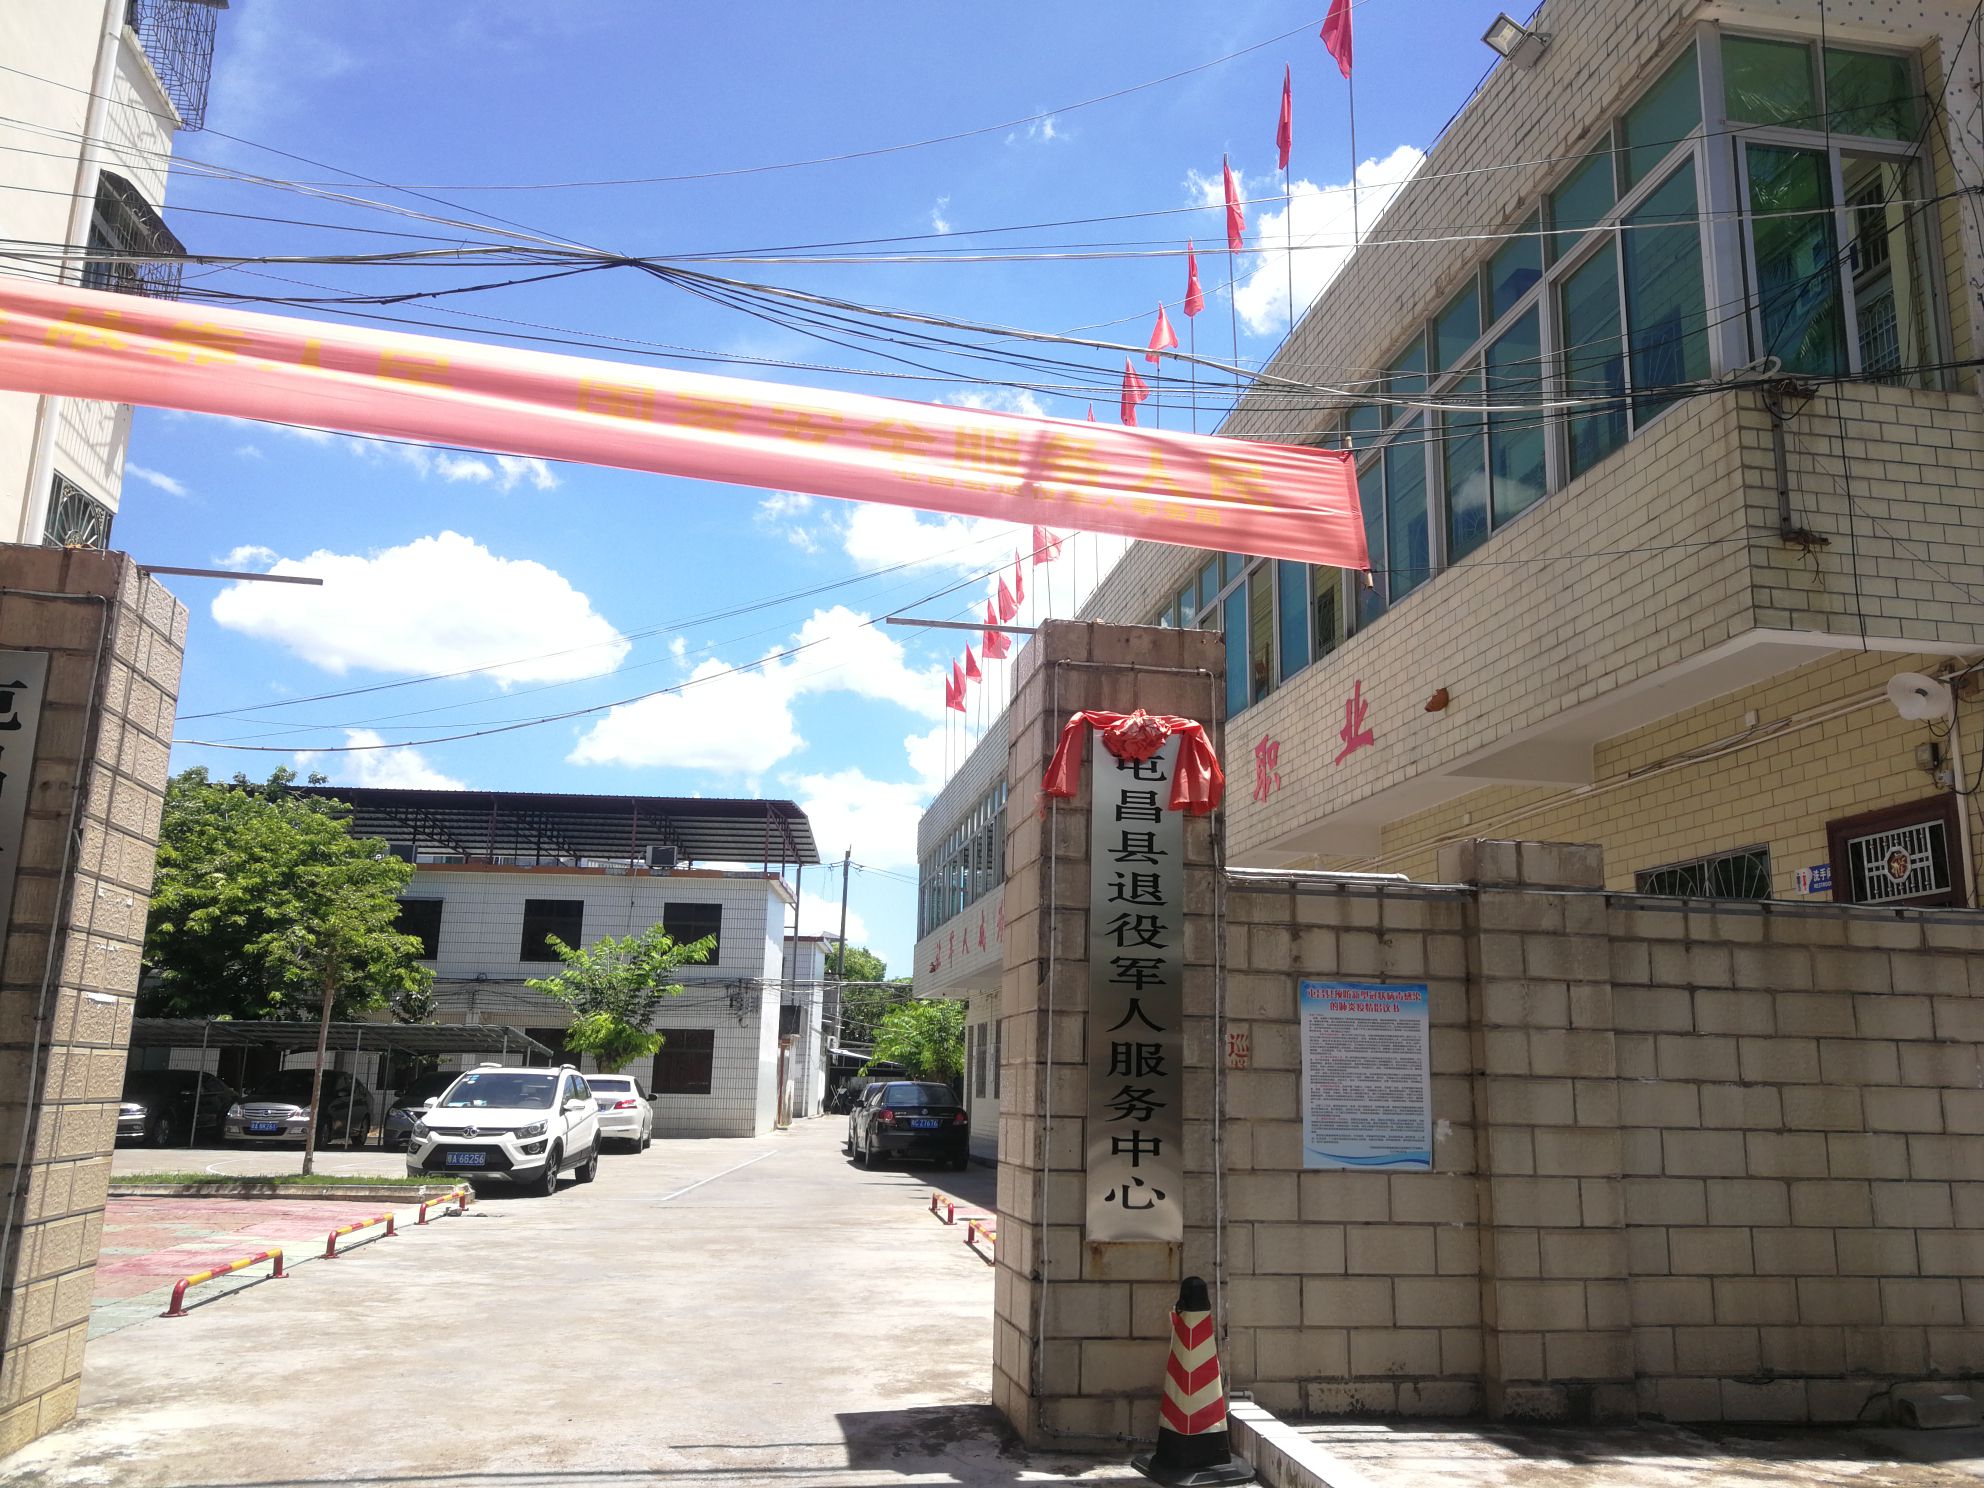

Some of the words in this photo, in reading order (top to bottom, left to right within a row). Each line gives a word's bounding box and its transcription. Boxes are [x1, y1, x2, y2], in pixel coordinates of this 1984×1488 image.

[1104, 753, 1169, 1210] 屯昌县退役军人服务中心
